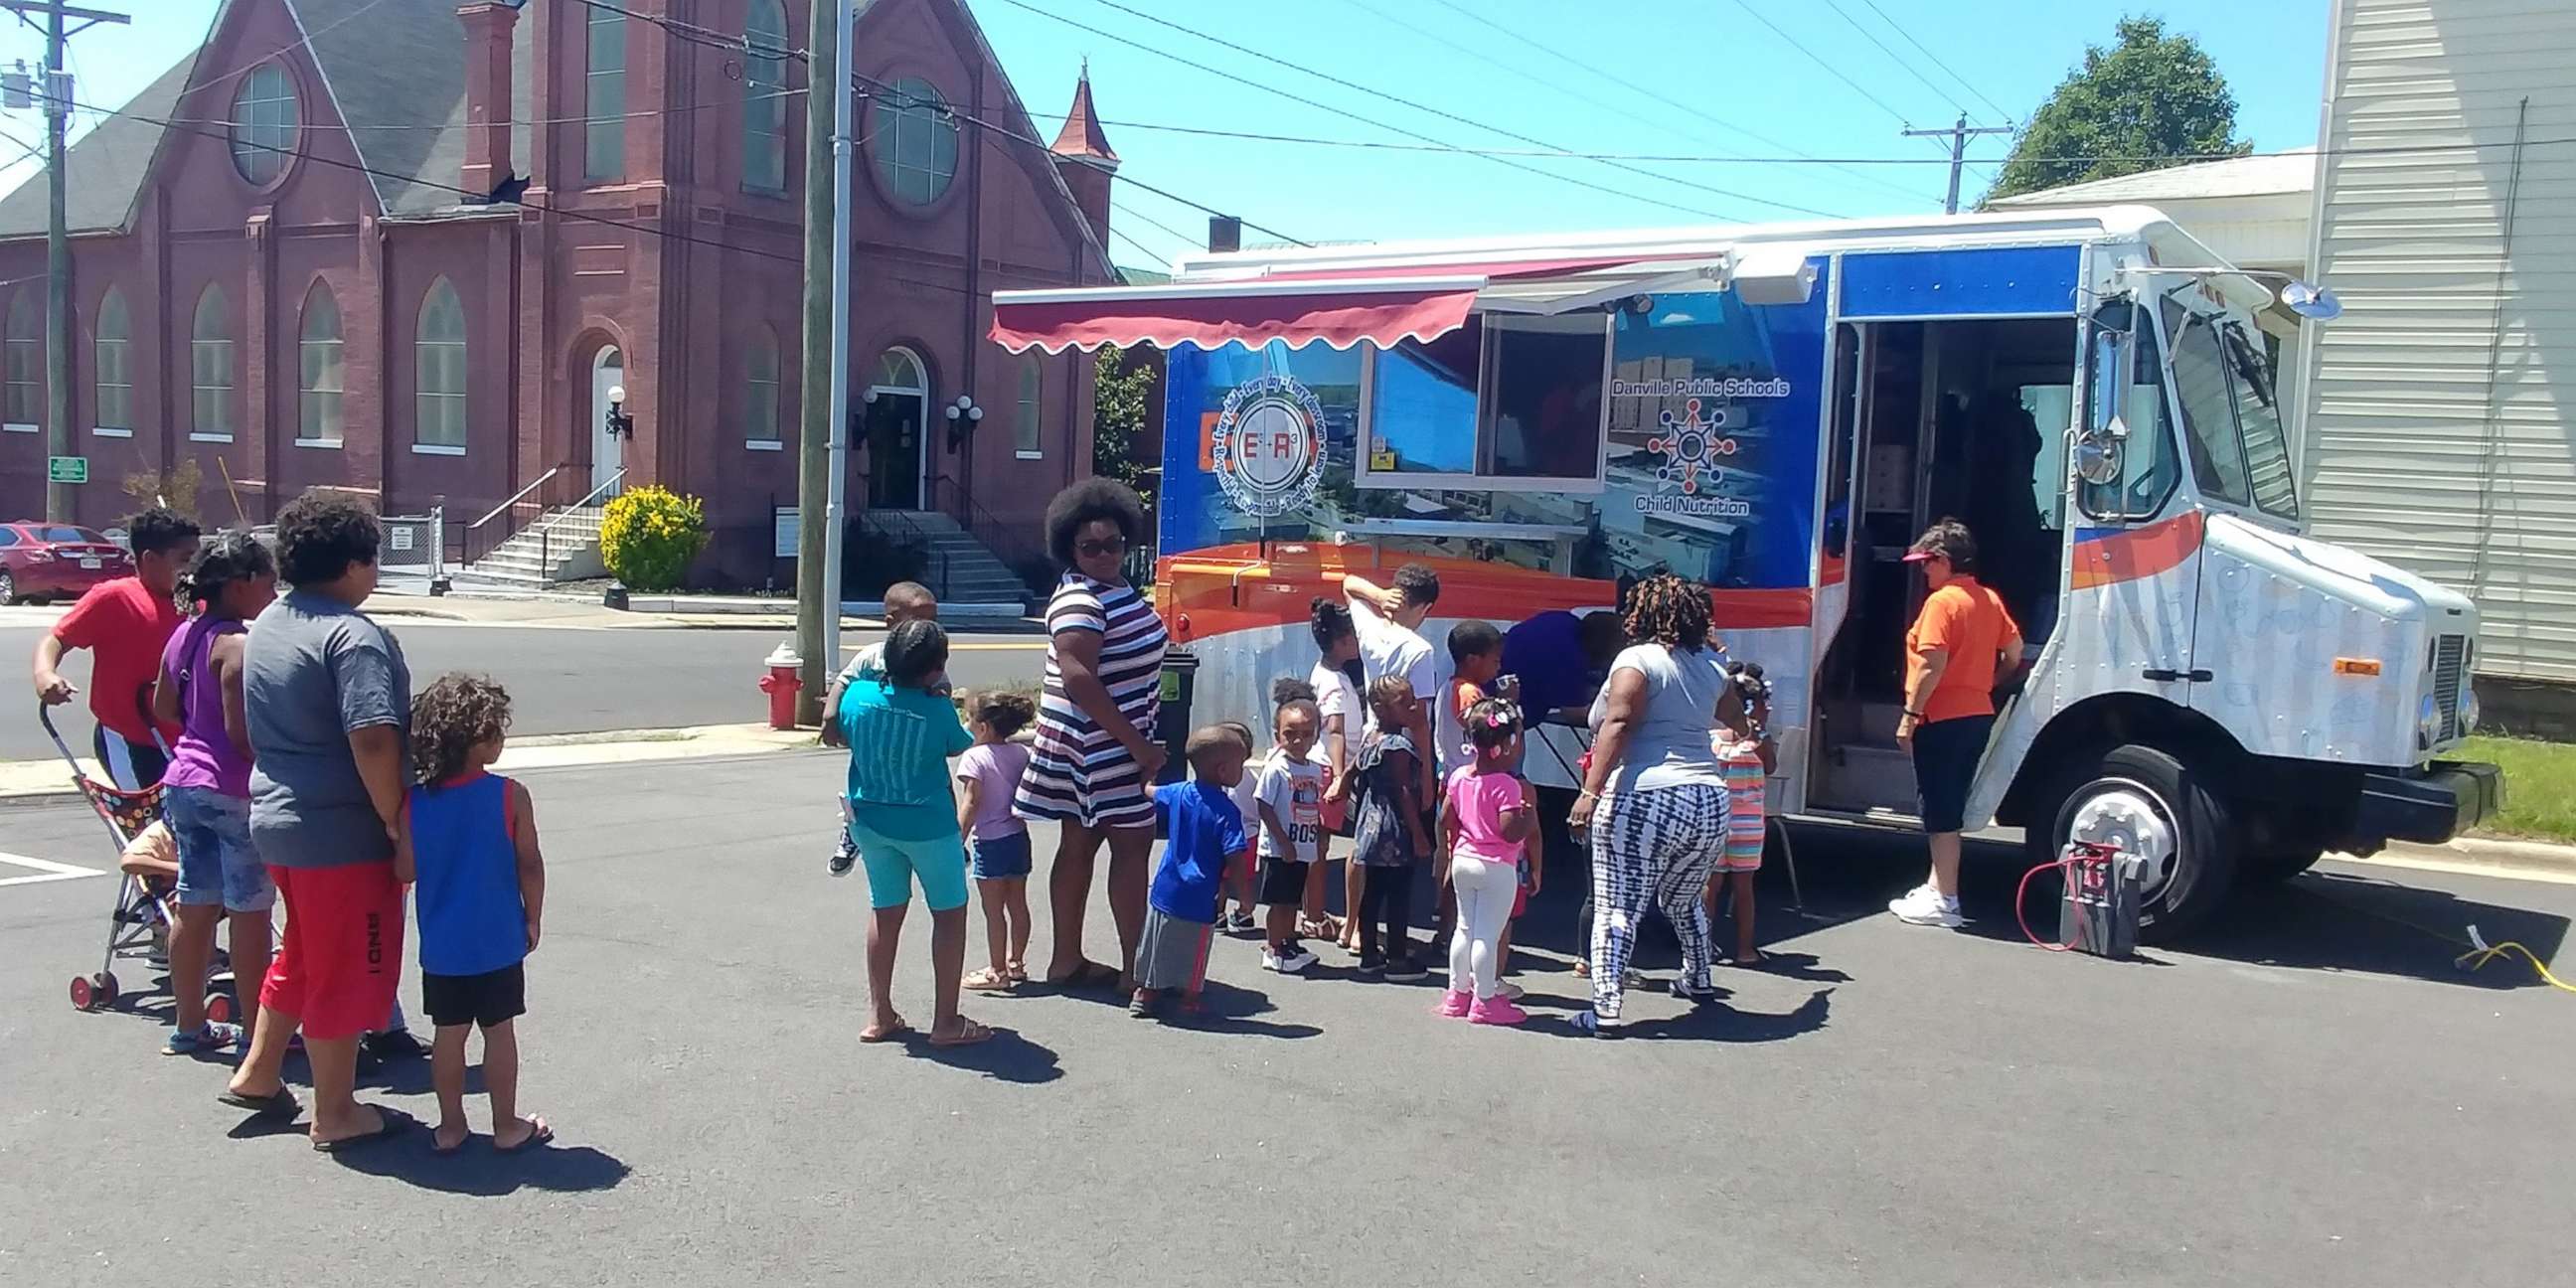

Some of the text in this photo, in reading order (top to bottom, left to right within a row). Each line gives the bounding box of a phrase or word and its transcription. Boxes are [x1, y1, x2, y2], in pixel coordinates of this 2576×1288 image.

[1612, 378, 1789, 396] Danville Public Schools
[1213, 412, 1233, 440] Every
[1267, 372, 1281, 393] day
[1288, 377, 1309, 402] Every
[1635, 496, 1747, 515] Child Nutrition
